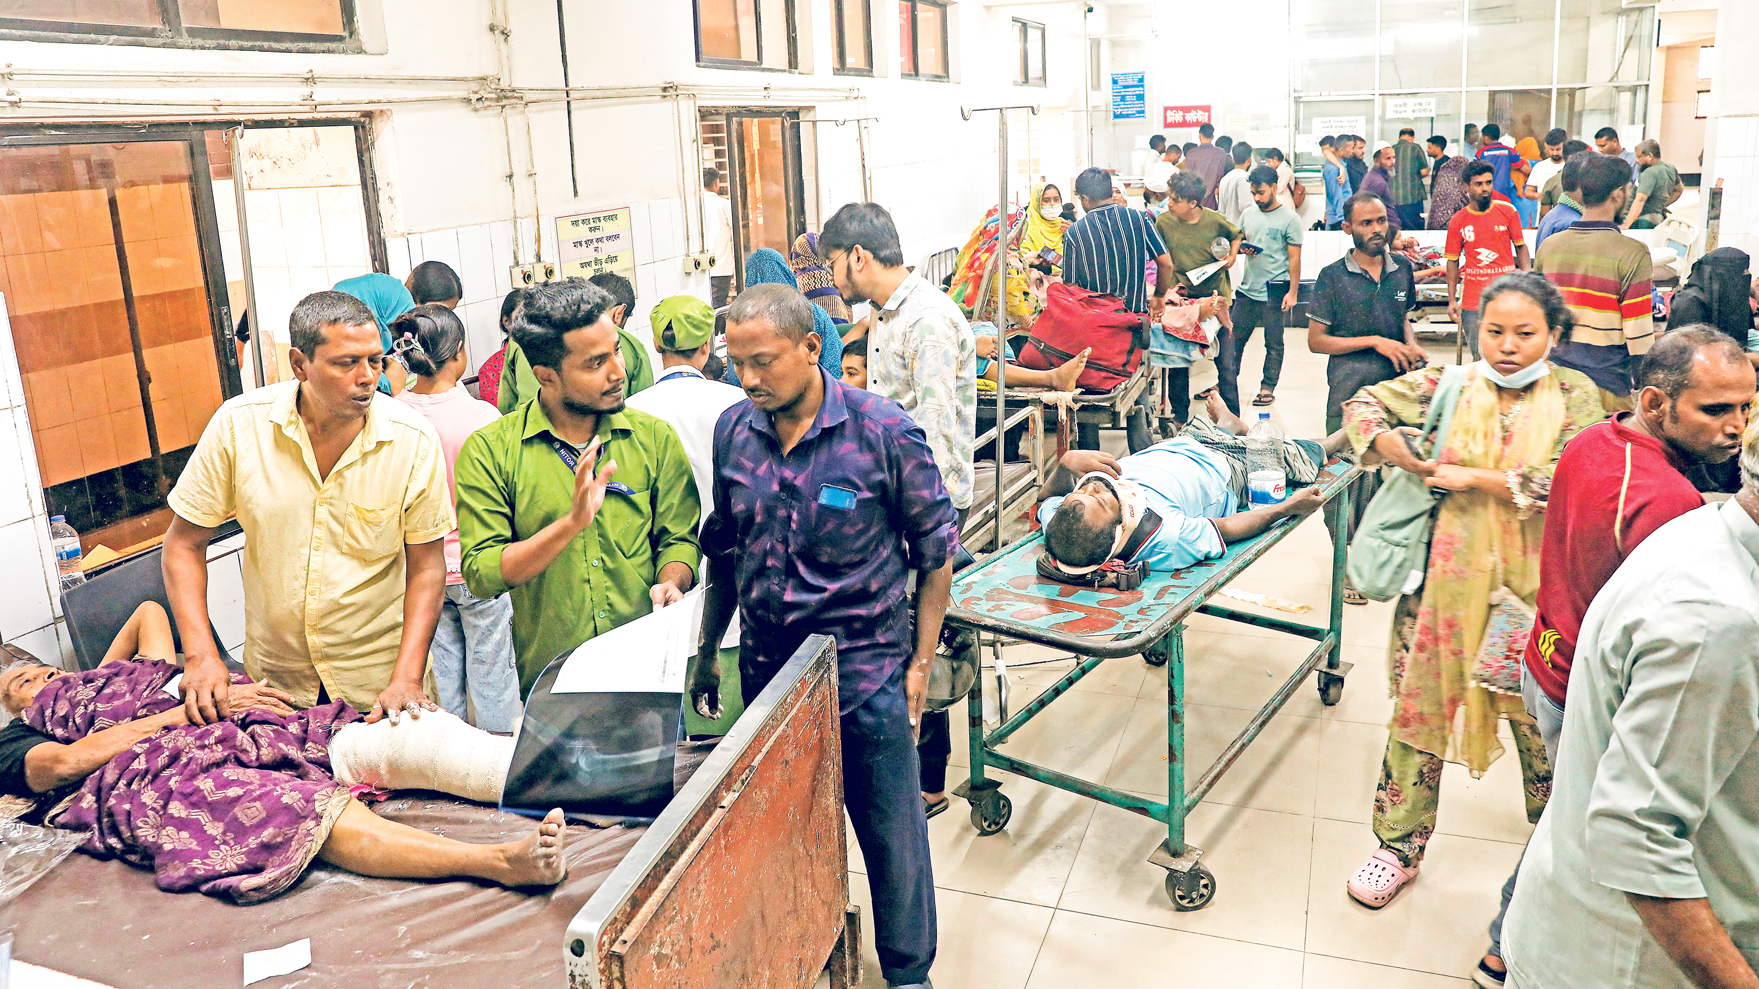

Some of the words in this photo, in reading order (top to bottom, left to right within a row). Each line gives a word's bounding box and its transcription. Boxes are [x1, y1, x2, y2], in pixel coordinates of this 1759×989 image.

[1165, 109, 1183, 124] টিকিট
[1184, 109, 1209, 124] কাউন্টার
[571, 219, 580, 227] দয়া
[581, 218, 591, 226] করে
[602, 214, 618, 222] ব্যবহার
[584, 239, 594, 248] খুলে
[595, 236, 605, 244] কথা
[605, 234, 620, 242] বলবেন
[559, 448, 575, 467] NITOR
